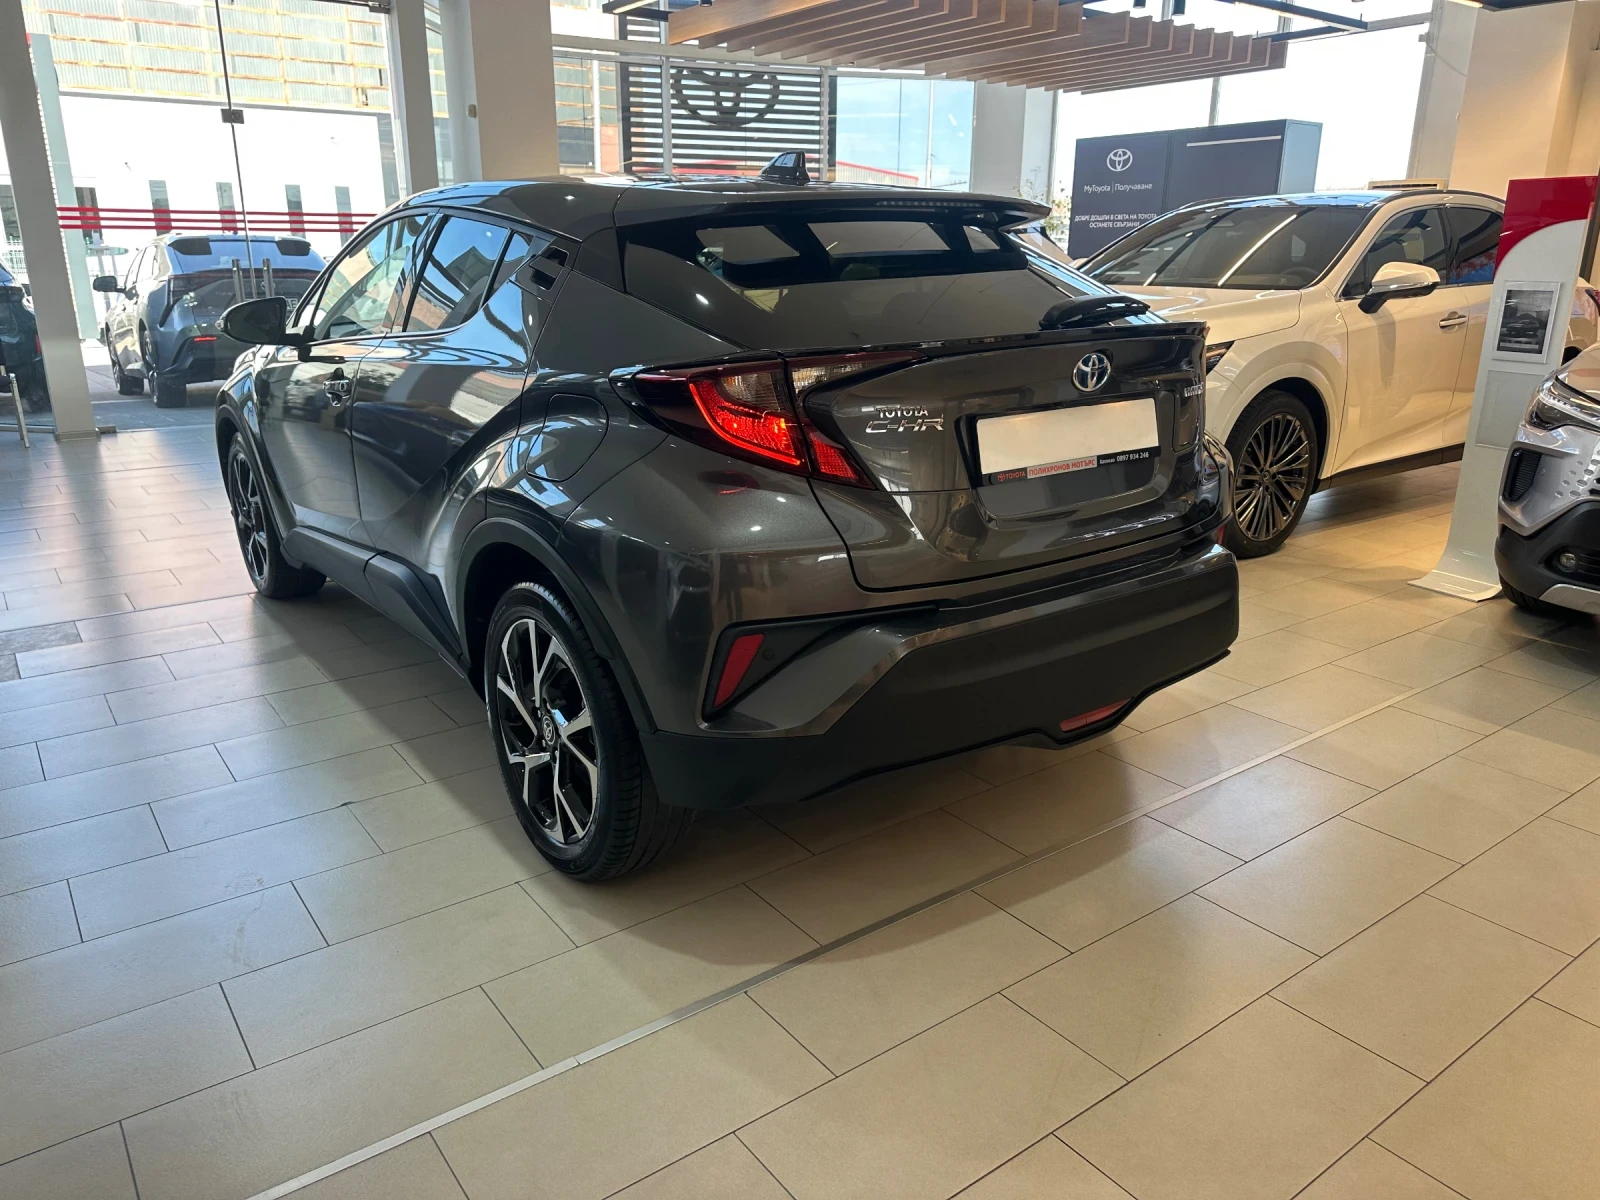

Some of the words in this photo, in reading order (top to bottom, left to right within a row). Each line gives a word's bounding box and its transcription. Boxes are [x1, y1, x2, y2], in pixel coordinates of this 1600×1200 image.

[1083, 184, 1111, 194] MyToyota
[1114, 183, 1153, 192] Получаване
[1074, 214, 1090, 222] ДОБРЕ
[1090, 214, 1110, 222] ДОШЛИ
[876, 405, 928, 418] TOYOTA
[865, 415, 944, 433] C-HR
[1116, 454, 1129, 462] 0897
[1139, 451, 1150, 459] 246
[1005, 471, 1026, 480] TOYOTA
[1028, 463, 1070, 477] ПОЛИХРОНОВ
[1071, 459, 1096, 470] МОТЪРС
